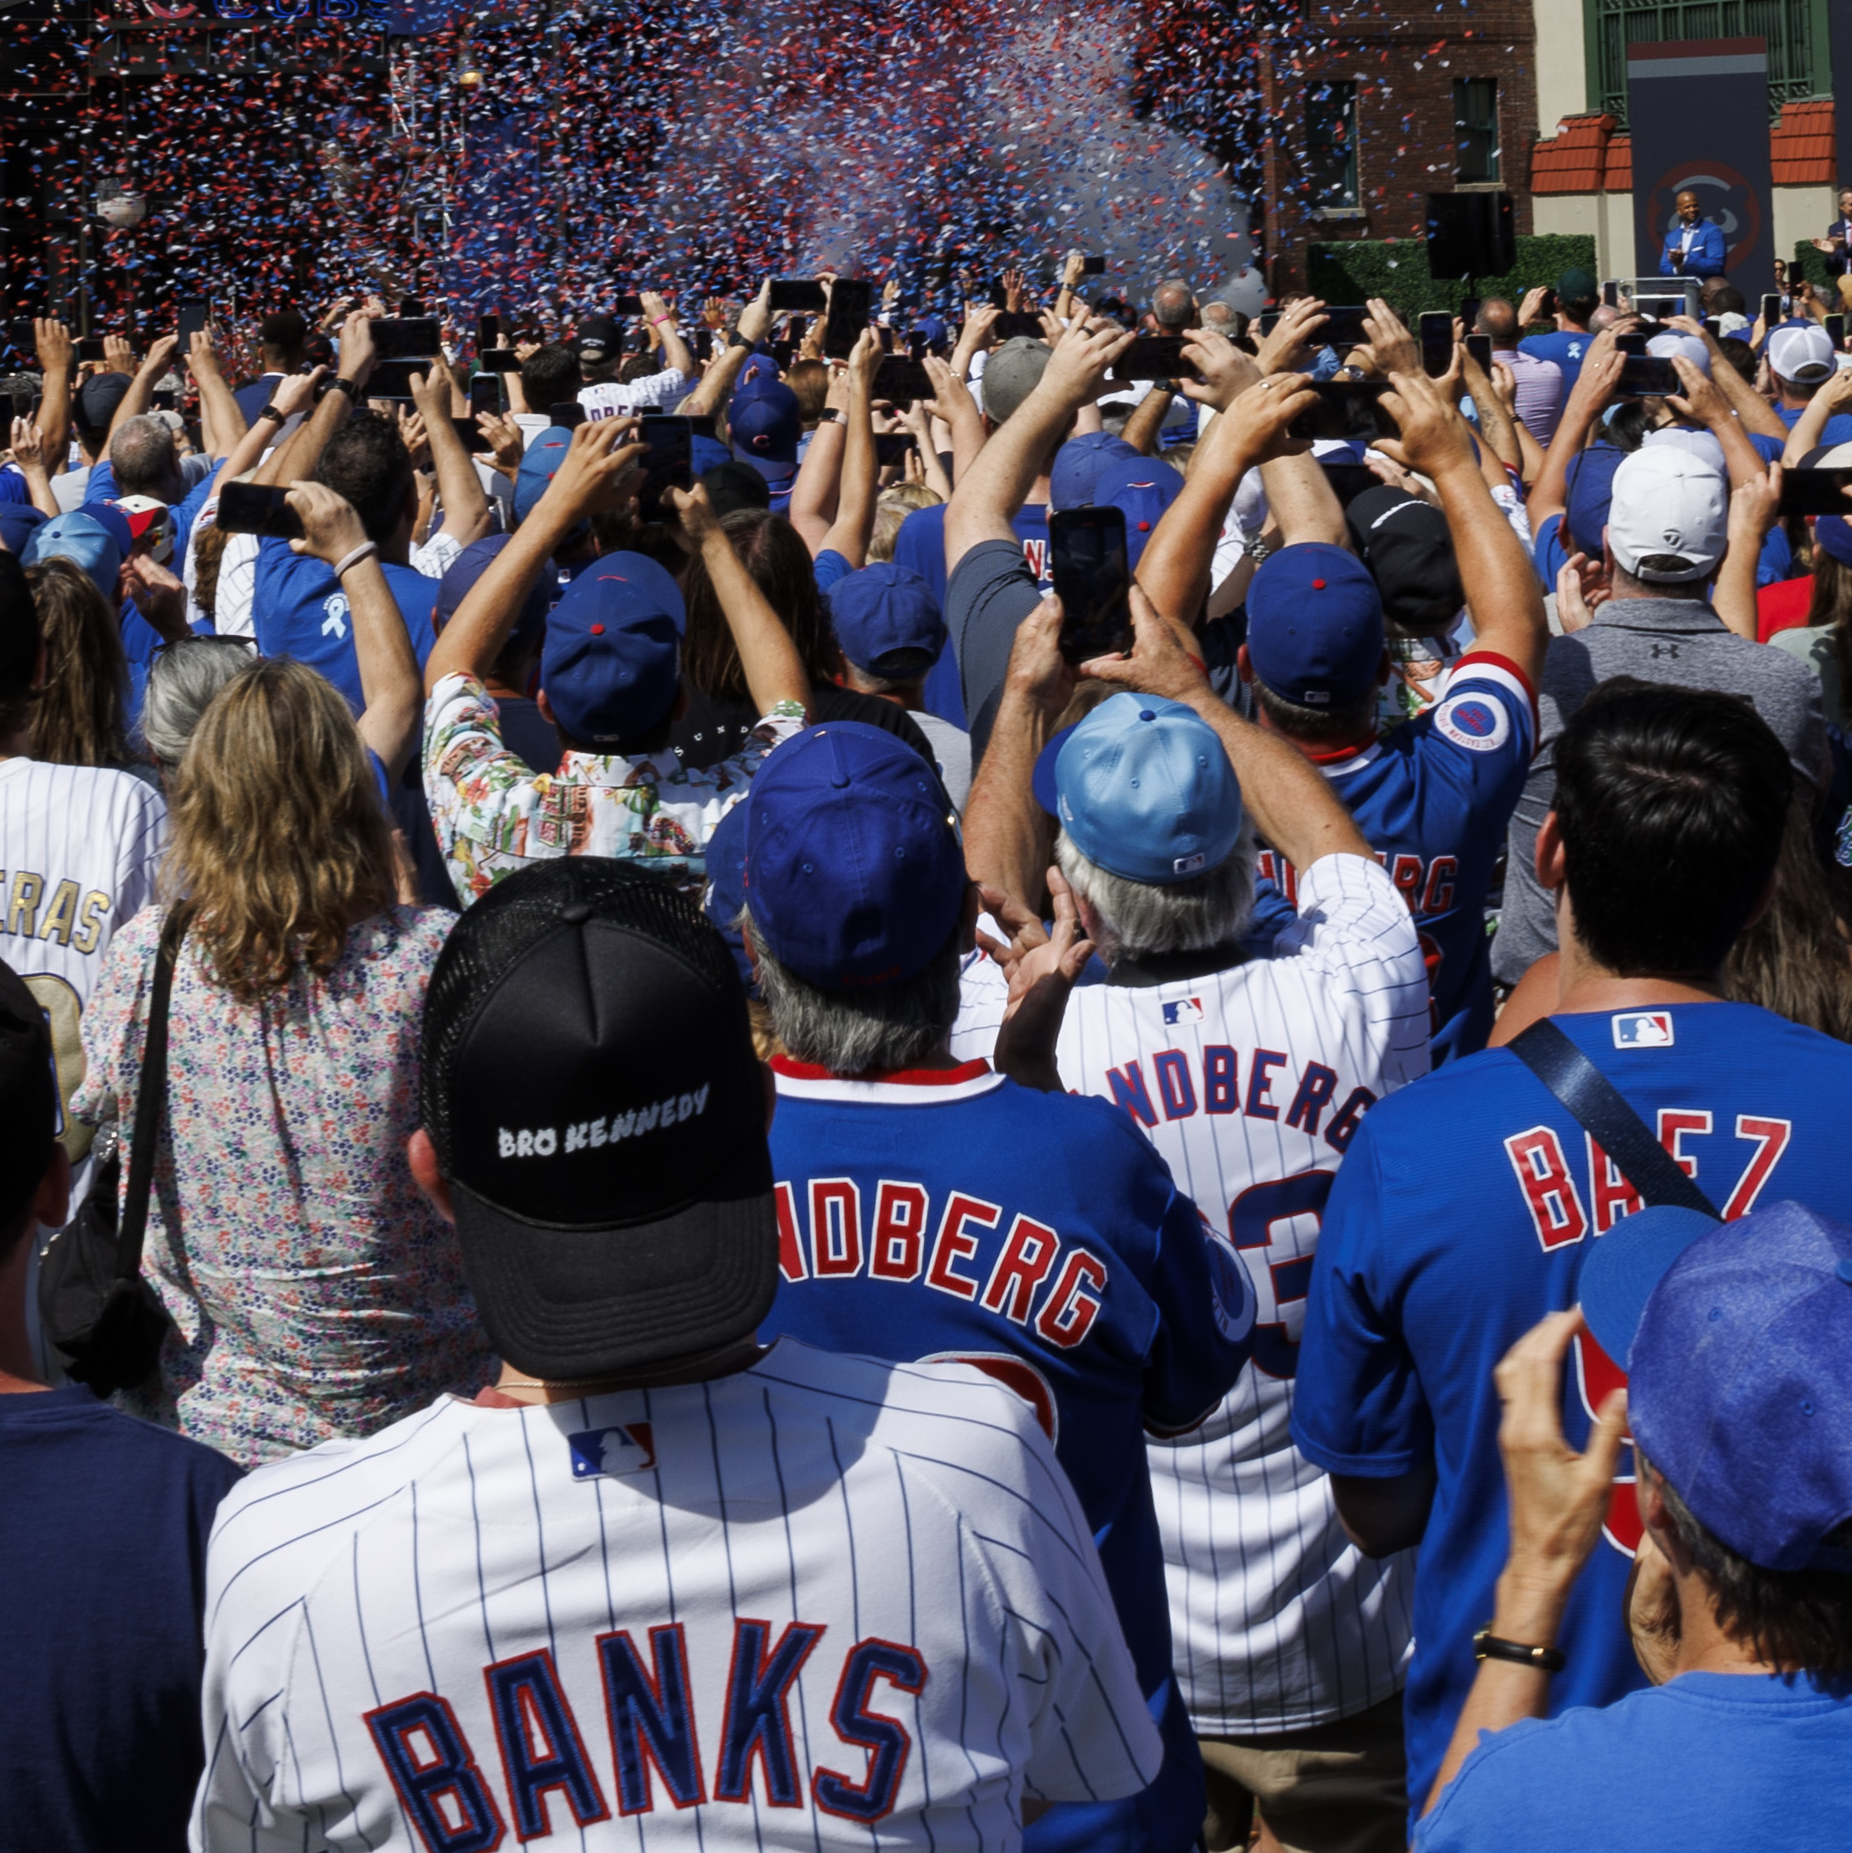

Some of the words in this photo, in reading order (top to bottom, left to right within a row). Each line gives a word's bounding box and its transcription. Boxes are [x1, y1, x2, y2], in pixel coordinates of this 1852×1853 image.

[498, 1126, 559, 1160] BRO
[563, 1083, 711, 1154] KENNEDY
[362, 1618, 925, 1853] BANKS
